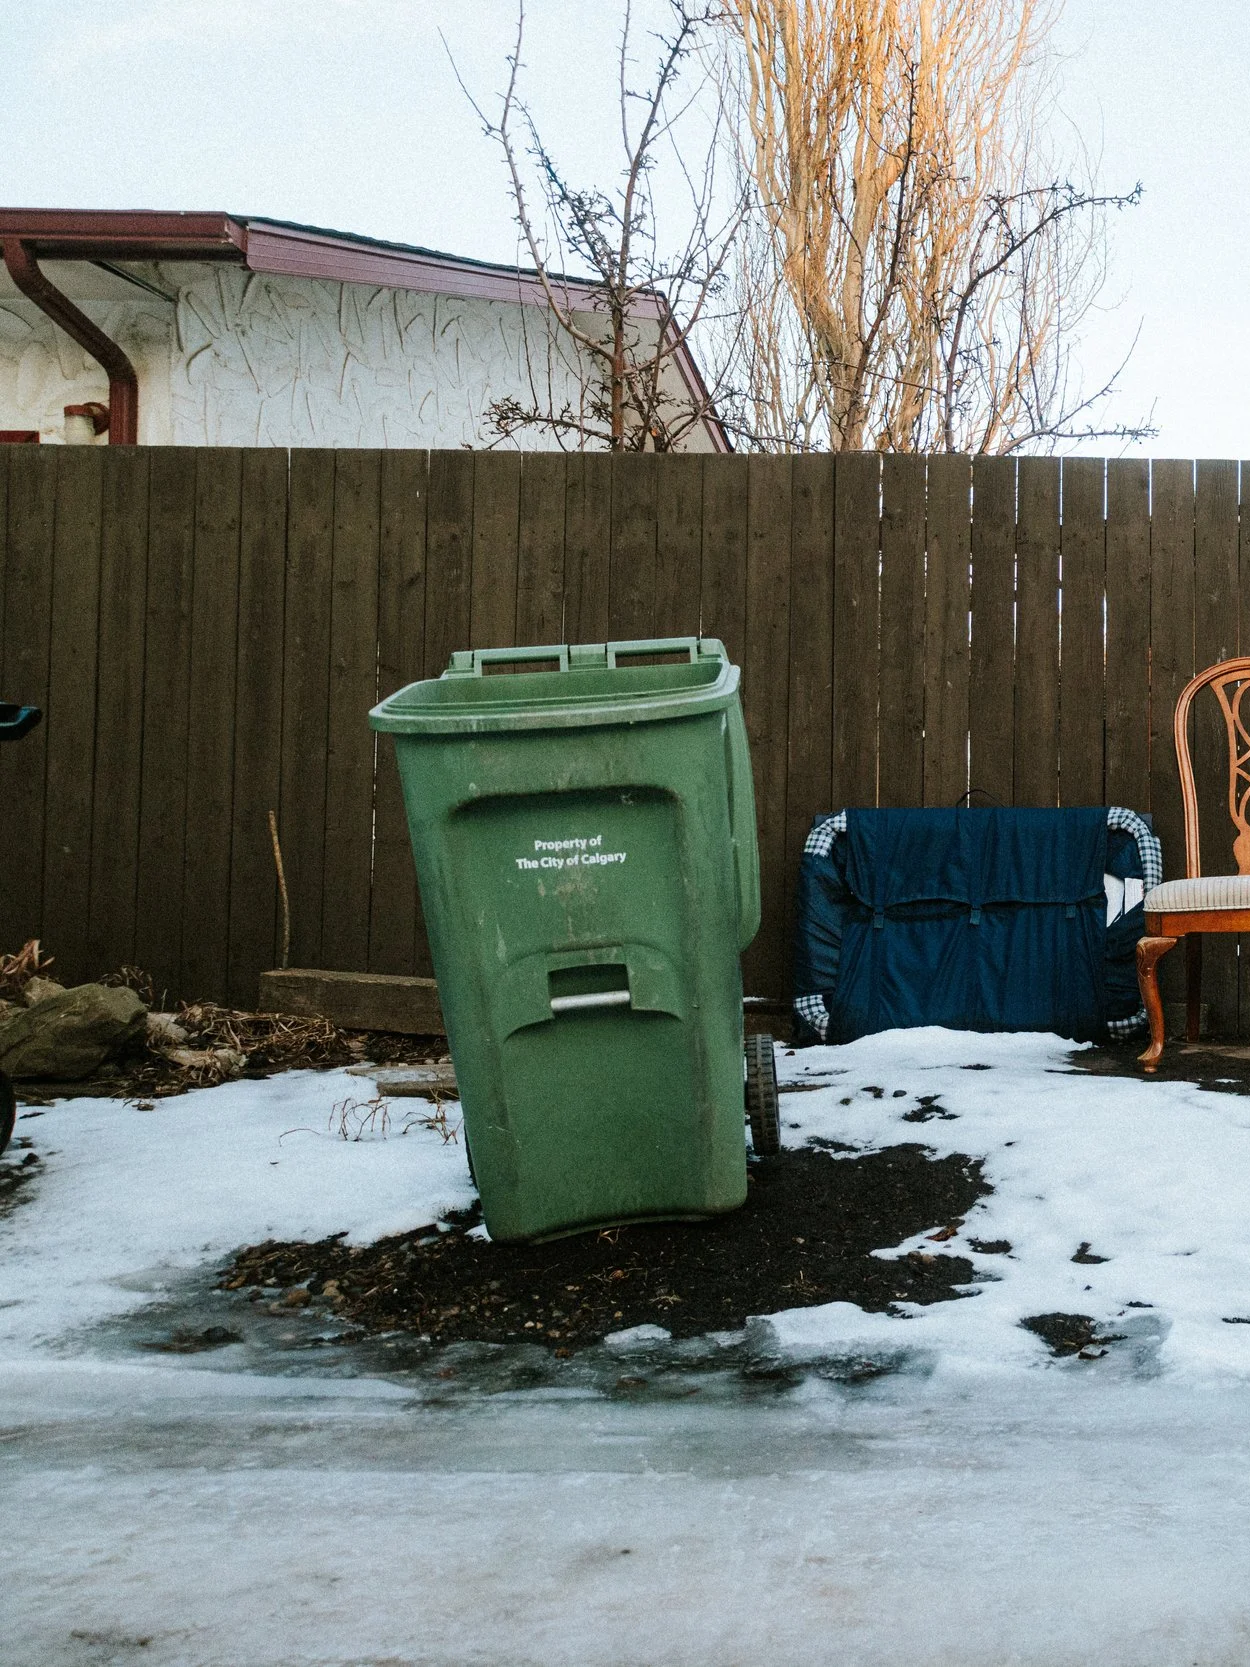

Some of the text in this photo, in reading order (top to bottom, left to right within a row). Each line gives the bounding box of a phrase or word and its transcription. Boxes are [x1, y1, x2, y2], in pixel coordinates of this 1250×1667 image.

[534, 835, 602, 851] Property of
[516, 852, 626, 869] The City of Calgary
